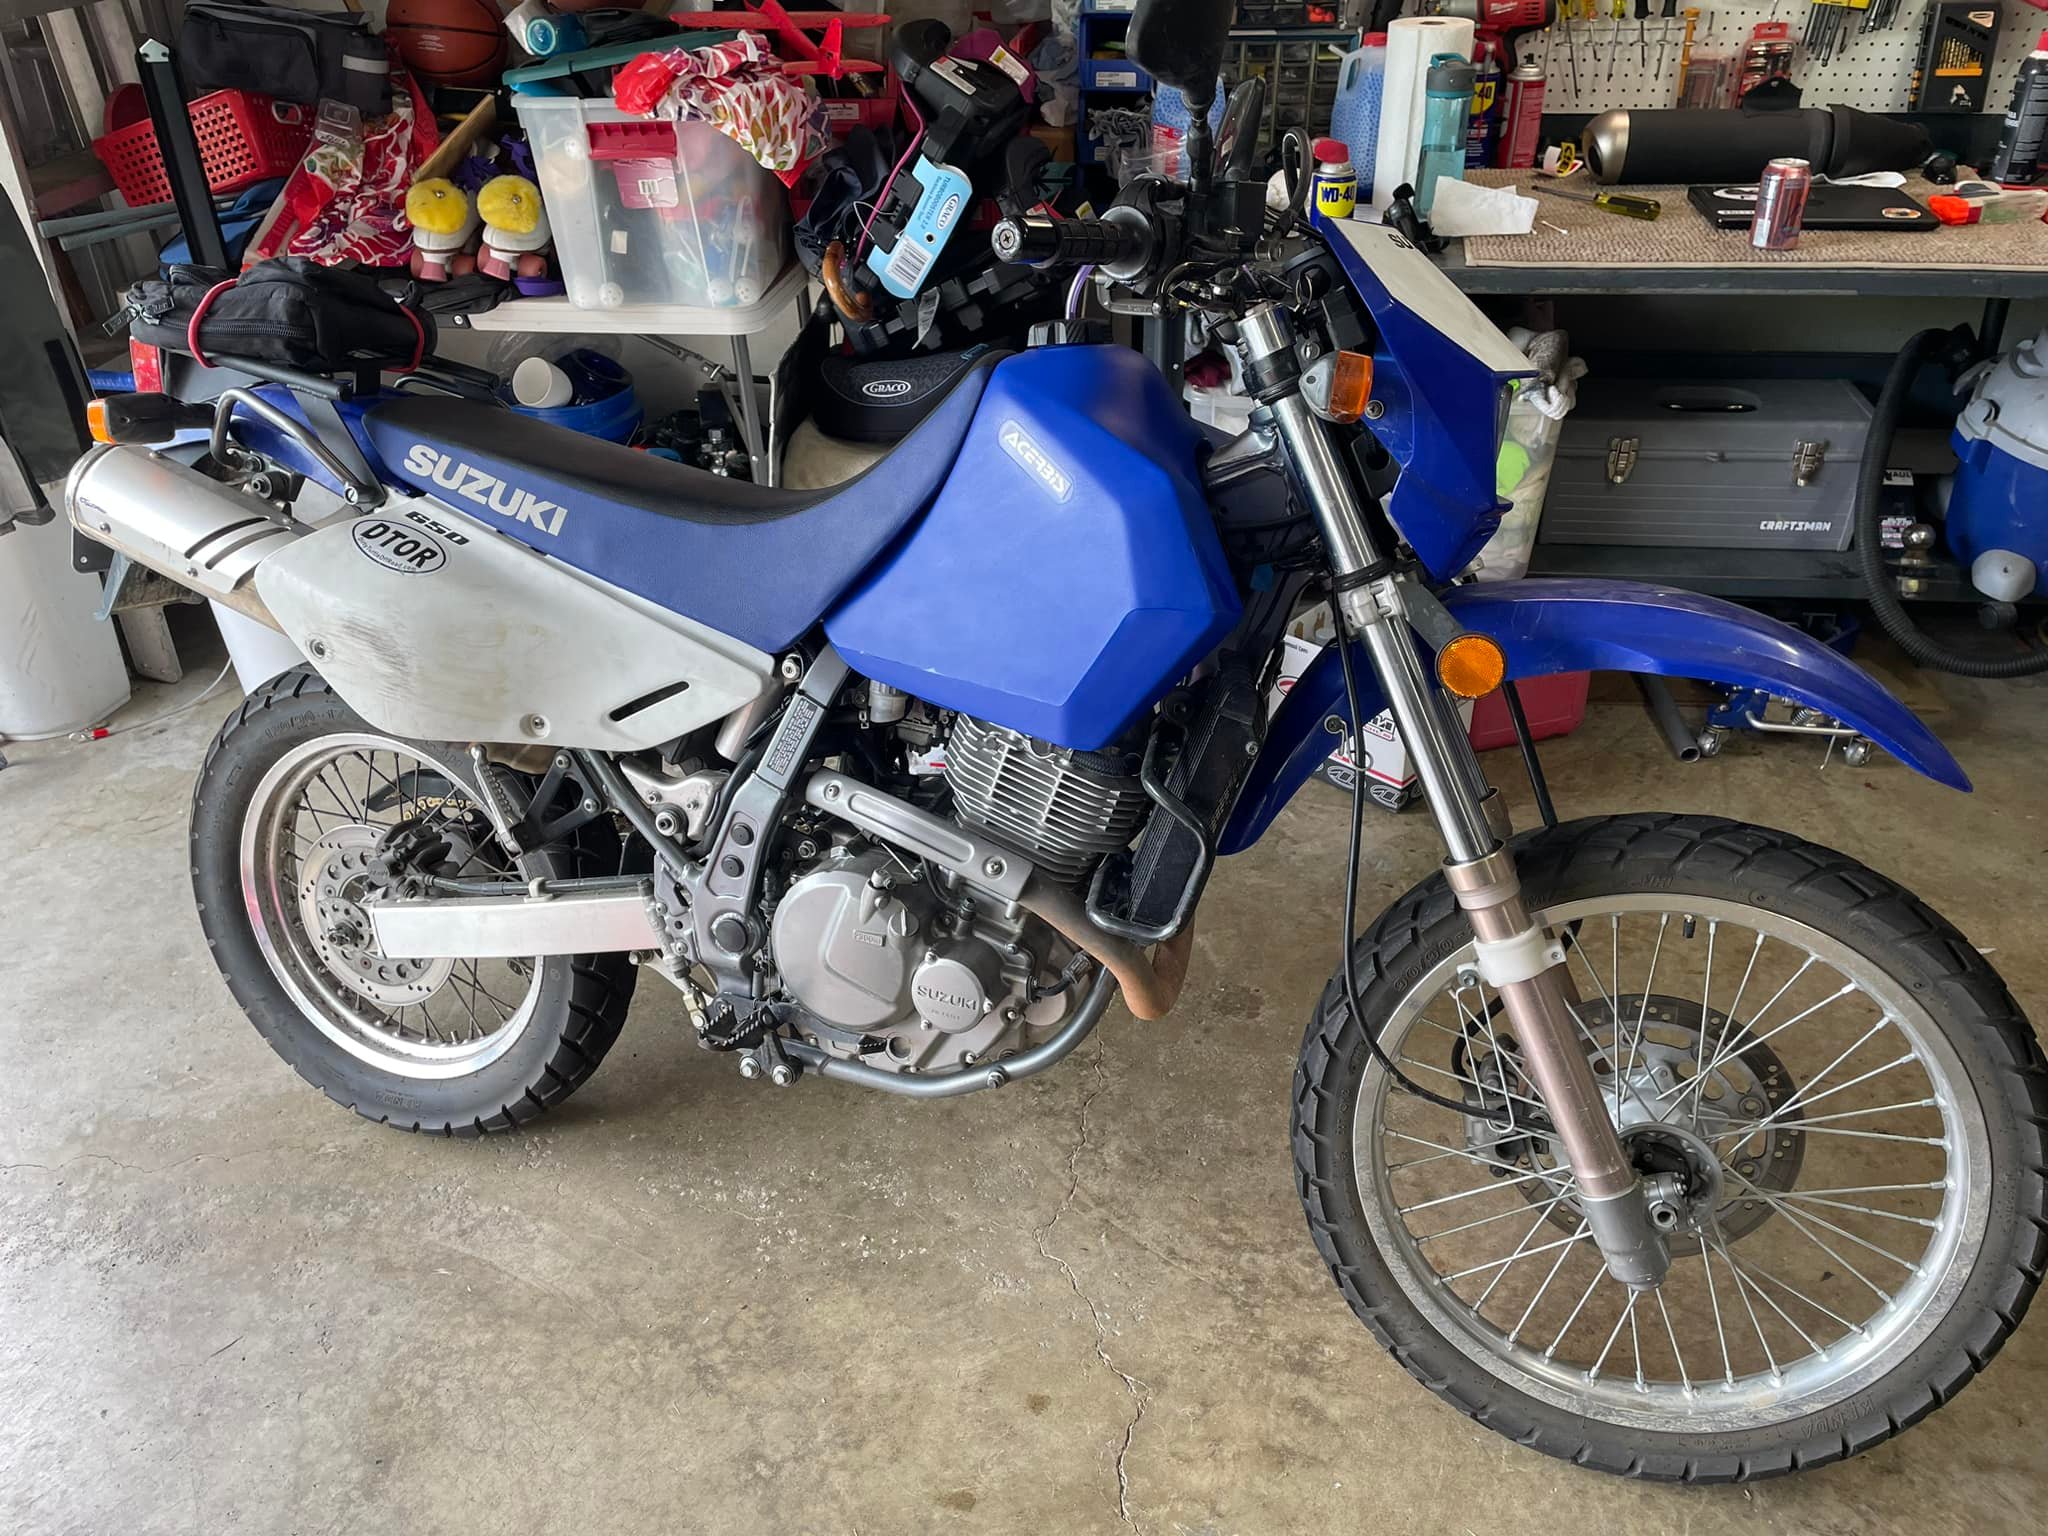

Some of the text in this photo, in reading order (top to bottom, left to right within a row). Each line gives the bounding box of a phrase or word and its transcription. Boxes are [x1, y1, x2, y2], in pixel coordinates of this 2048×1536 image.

[1321, 185, 1356, 203] WD-40
[938, 197, 957, 228] GRACO
[868, 382, 908, 394] GRACO
[403, 444, 568, 537] SUZUKI
[405, 511, 470, 546] 650
[1759, 520, 1832, 532] CRAFTSMAN
[360, 522, 438, 569] DTOR
[916, 984, 978, 1011] SUZUKI
